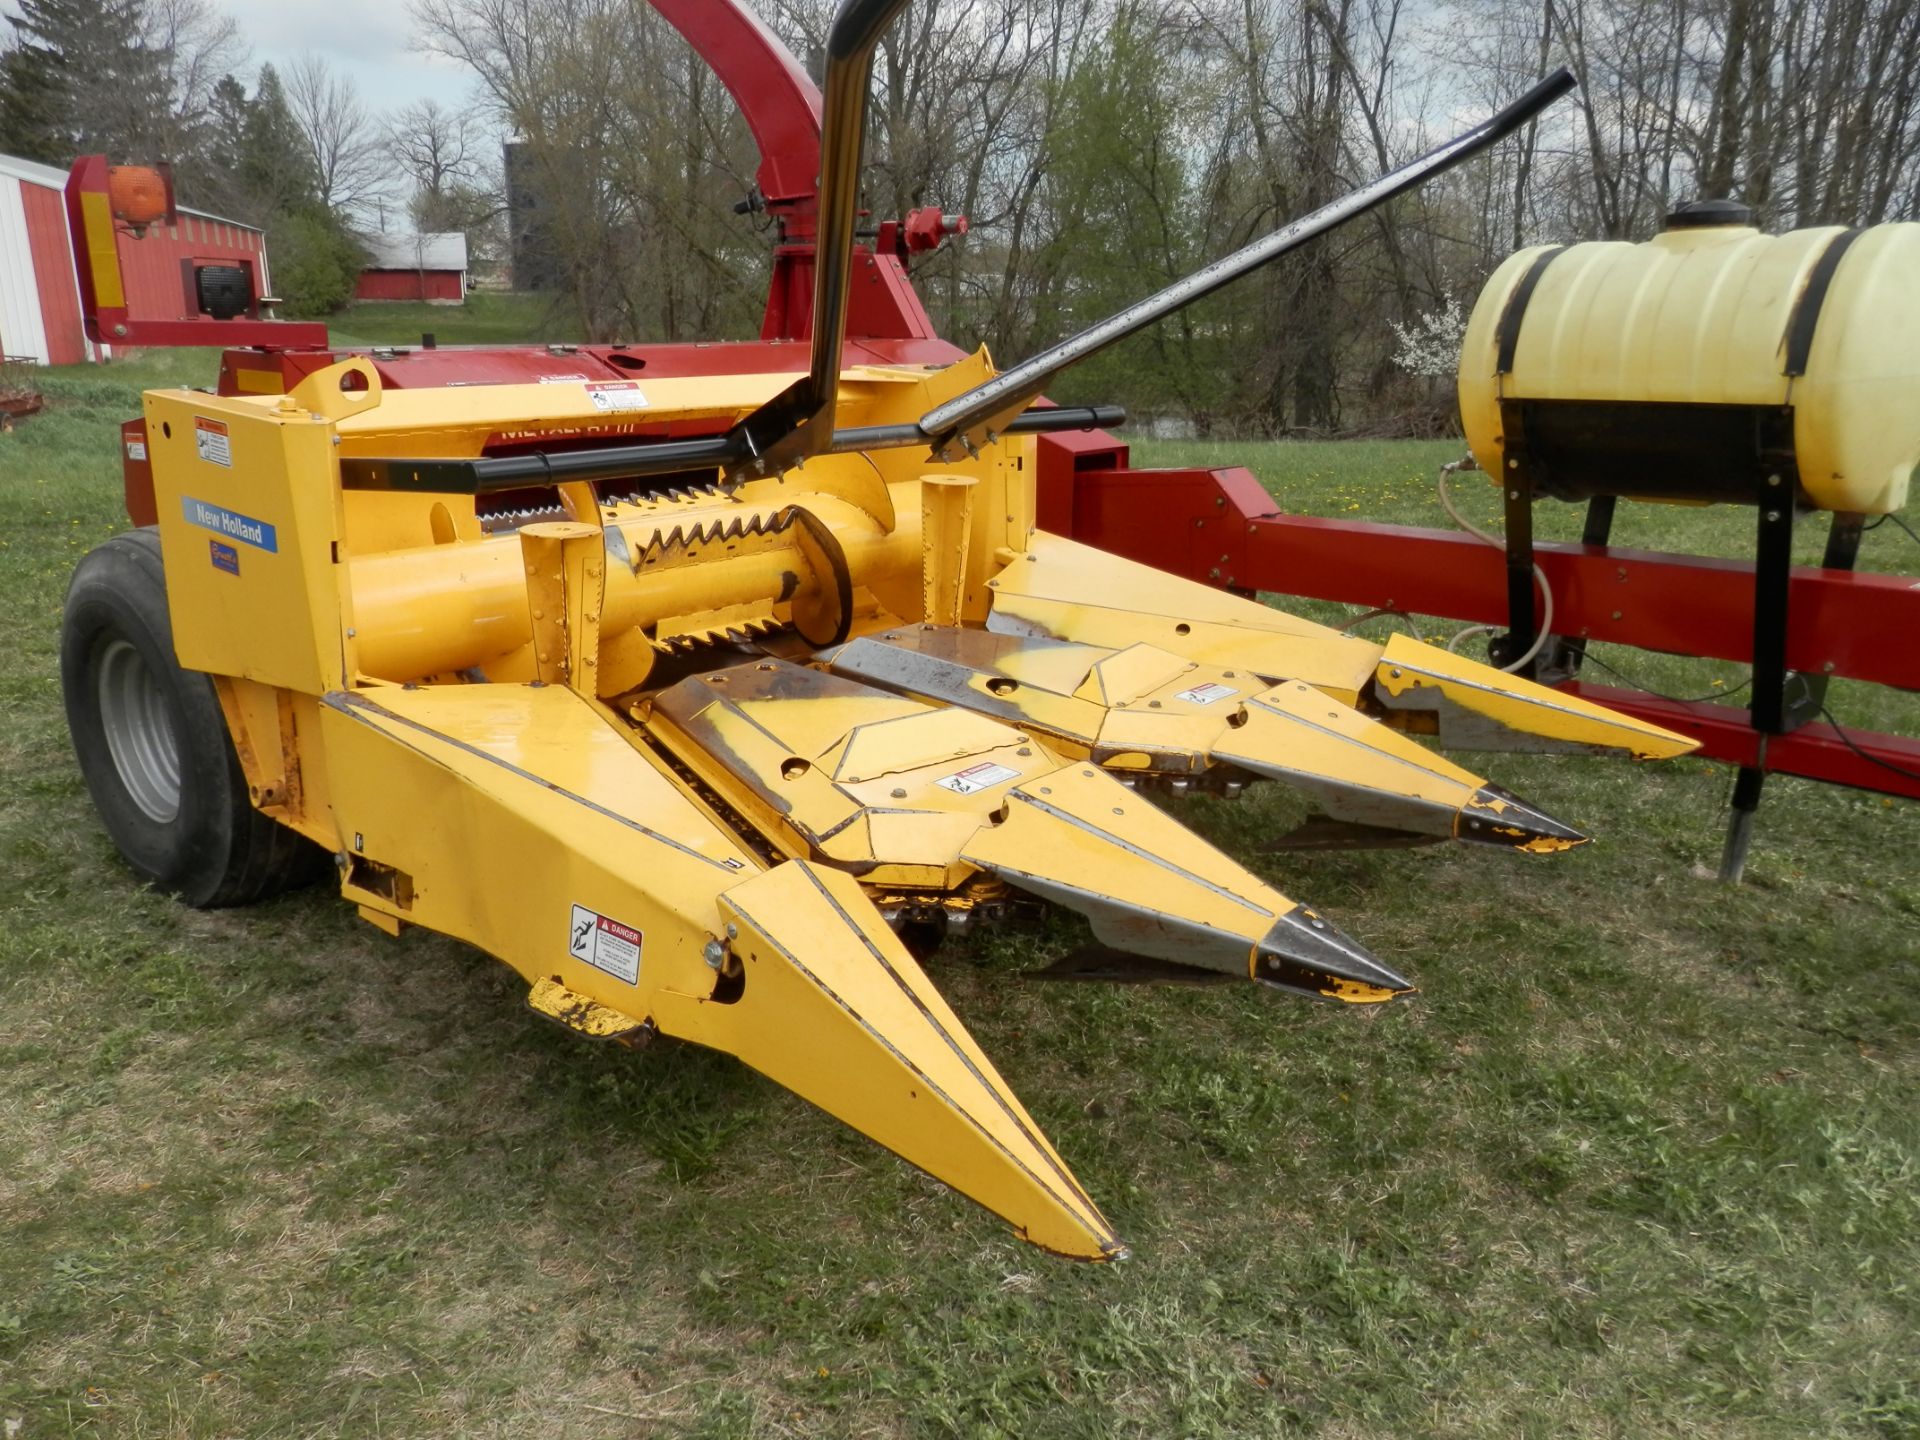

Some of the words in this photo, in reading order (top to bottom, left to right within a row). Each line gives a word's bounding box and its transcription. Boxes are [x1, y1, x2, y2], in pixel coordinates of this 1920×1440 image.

[196, 503, 220, 528] New
[221, 511, 263, 544] Holland
[611, 924, 639, 942] DANGER
